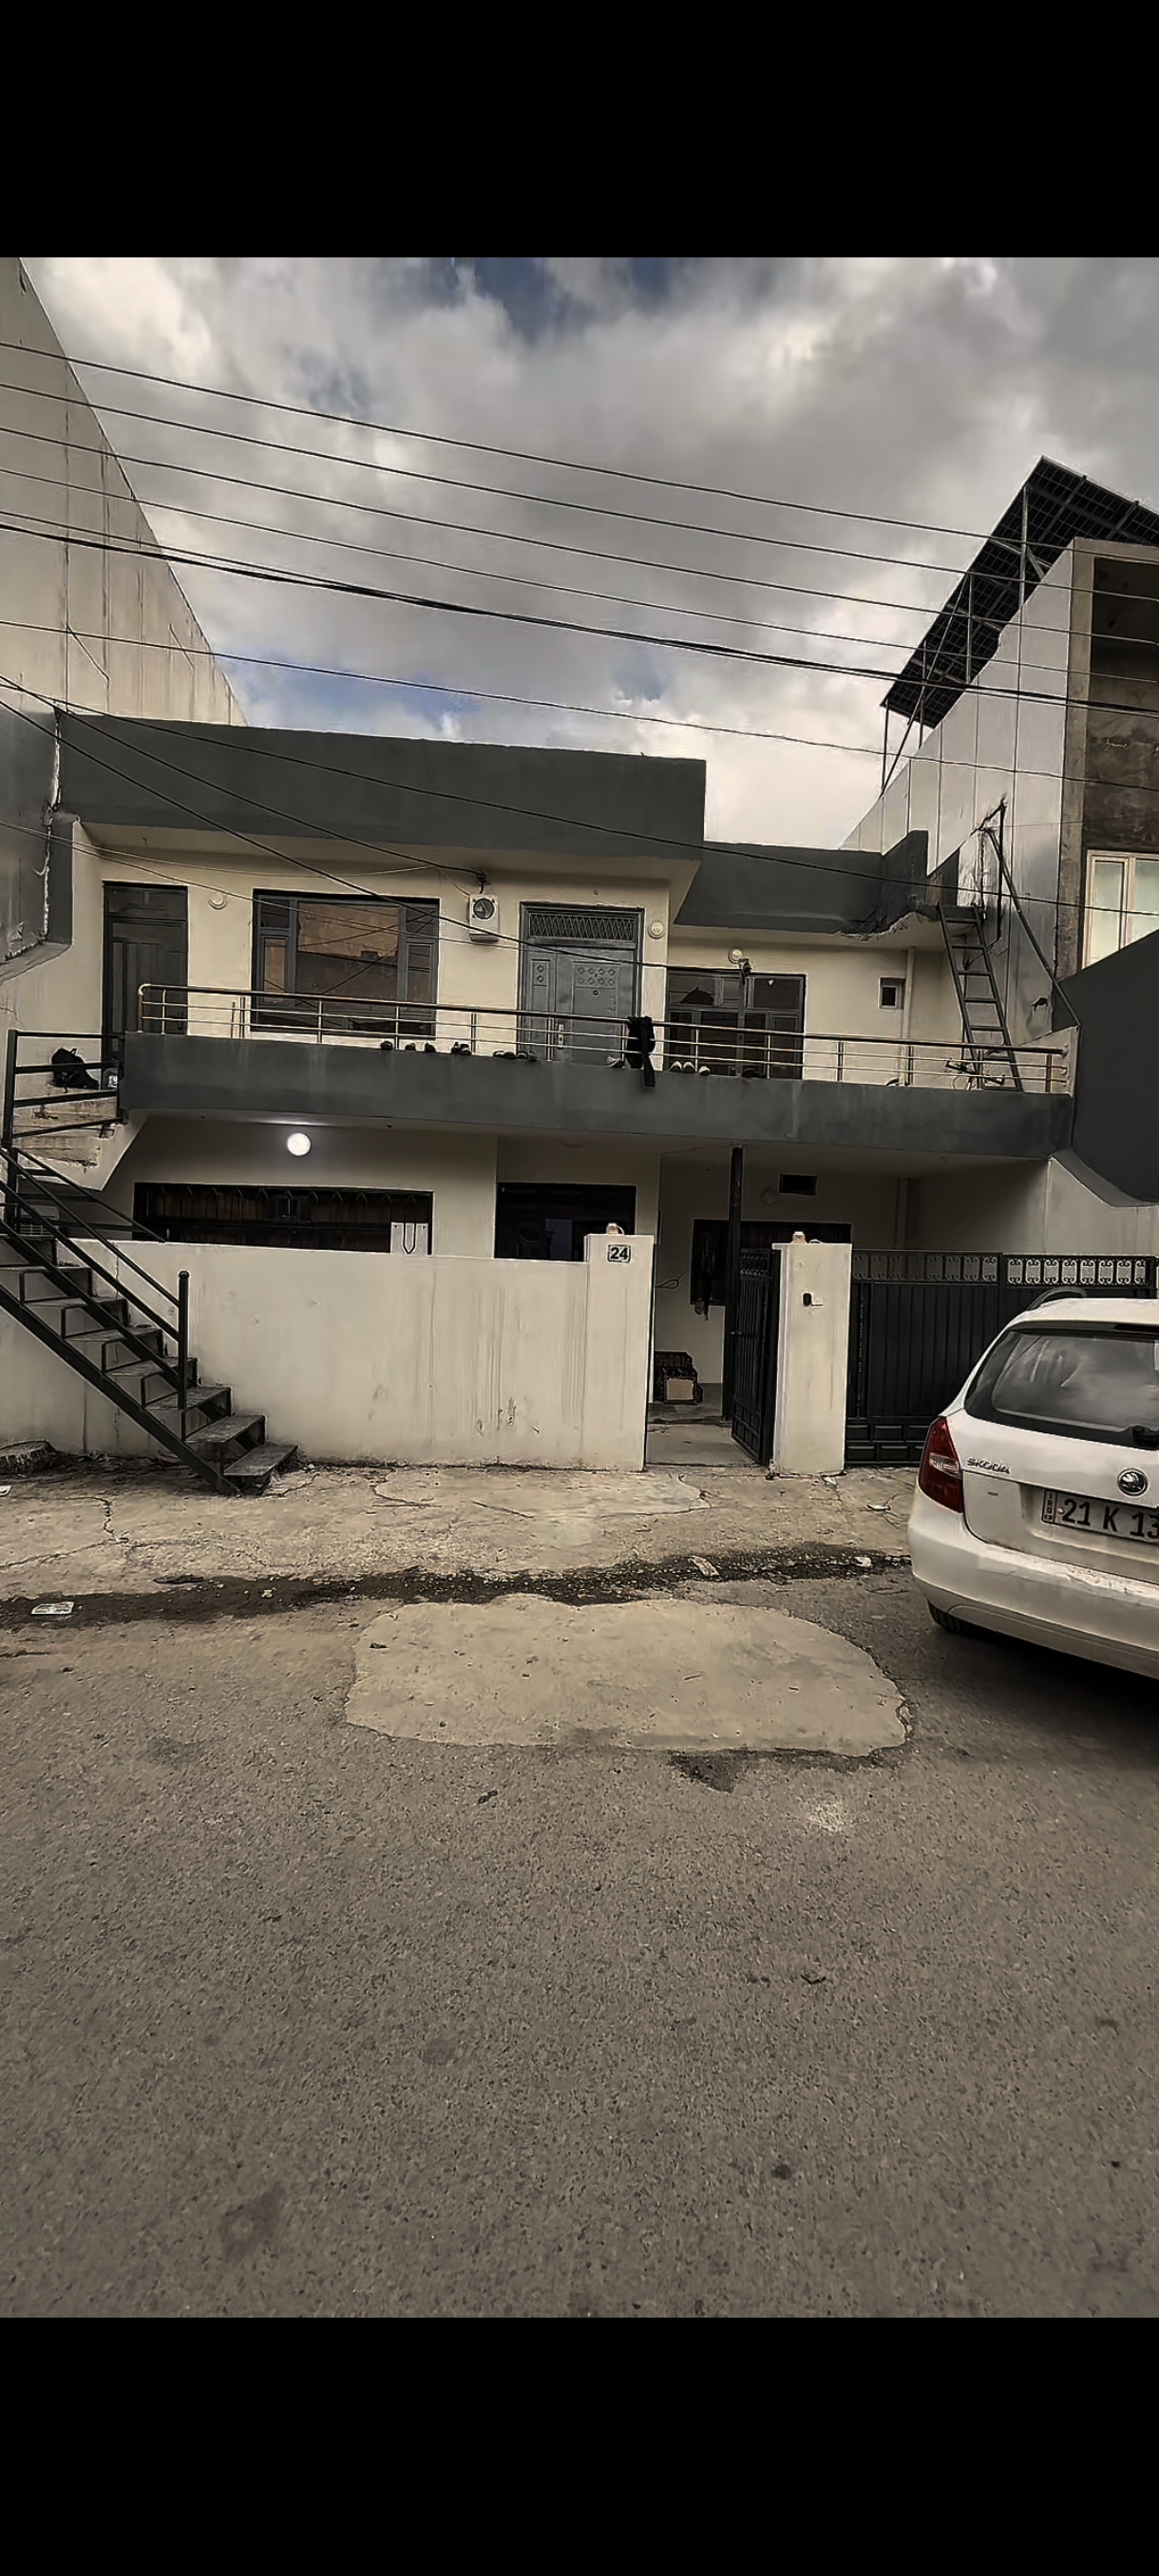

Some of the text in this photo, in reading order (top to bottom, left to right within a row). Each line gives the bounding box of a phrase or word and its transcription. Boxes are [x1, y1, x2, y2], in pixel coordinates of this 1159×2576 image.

[611, 1247, 628, 1260] 24
[1062, 1498, 1092, 1526] 21
[1103, 1506, 1120, 1533] K
